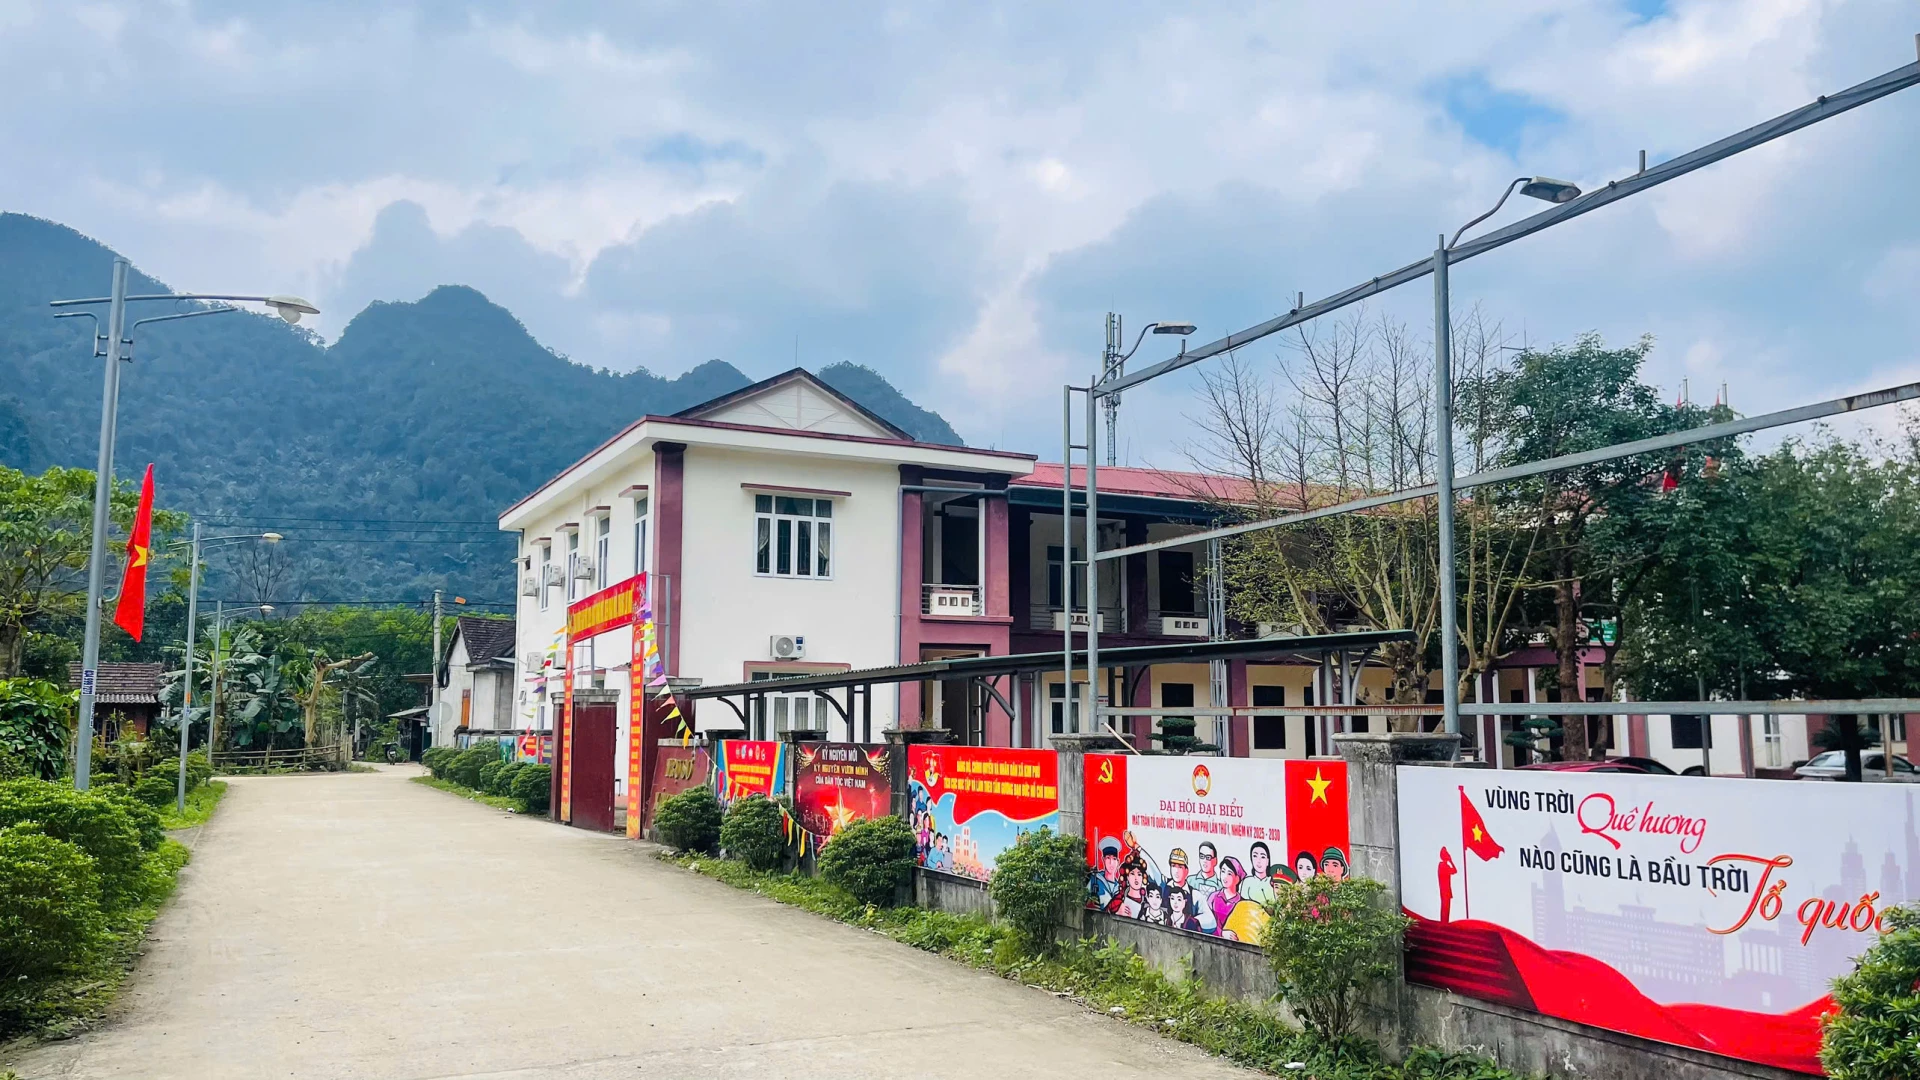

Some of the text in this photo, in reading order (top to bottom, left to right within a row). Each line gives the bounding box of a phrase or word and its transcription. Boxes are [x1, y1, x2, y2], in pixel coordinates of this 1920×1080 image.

[1159, 797, 1244, 818] ĐẠI HỘI ĐẠI BIỂU
[1485, 787, 1707, 854] VÙNG TRỜI Quê hương
[1253, 826, 1265, 840] 2025
[1520, 846, 1556, 871] NÀO
[1560, 850, 1612, 878] CŨNG
[1617, 855, 1643, 882] LÀ
[1648, 854, 1691, 887] BẦU
[1697, 864, 1750, 894] TRỜI
[1705, 853, 1794, 935] Tổ
